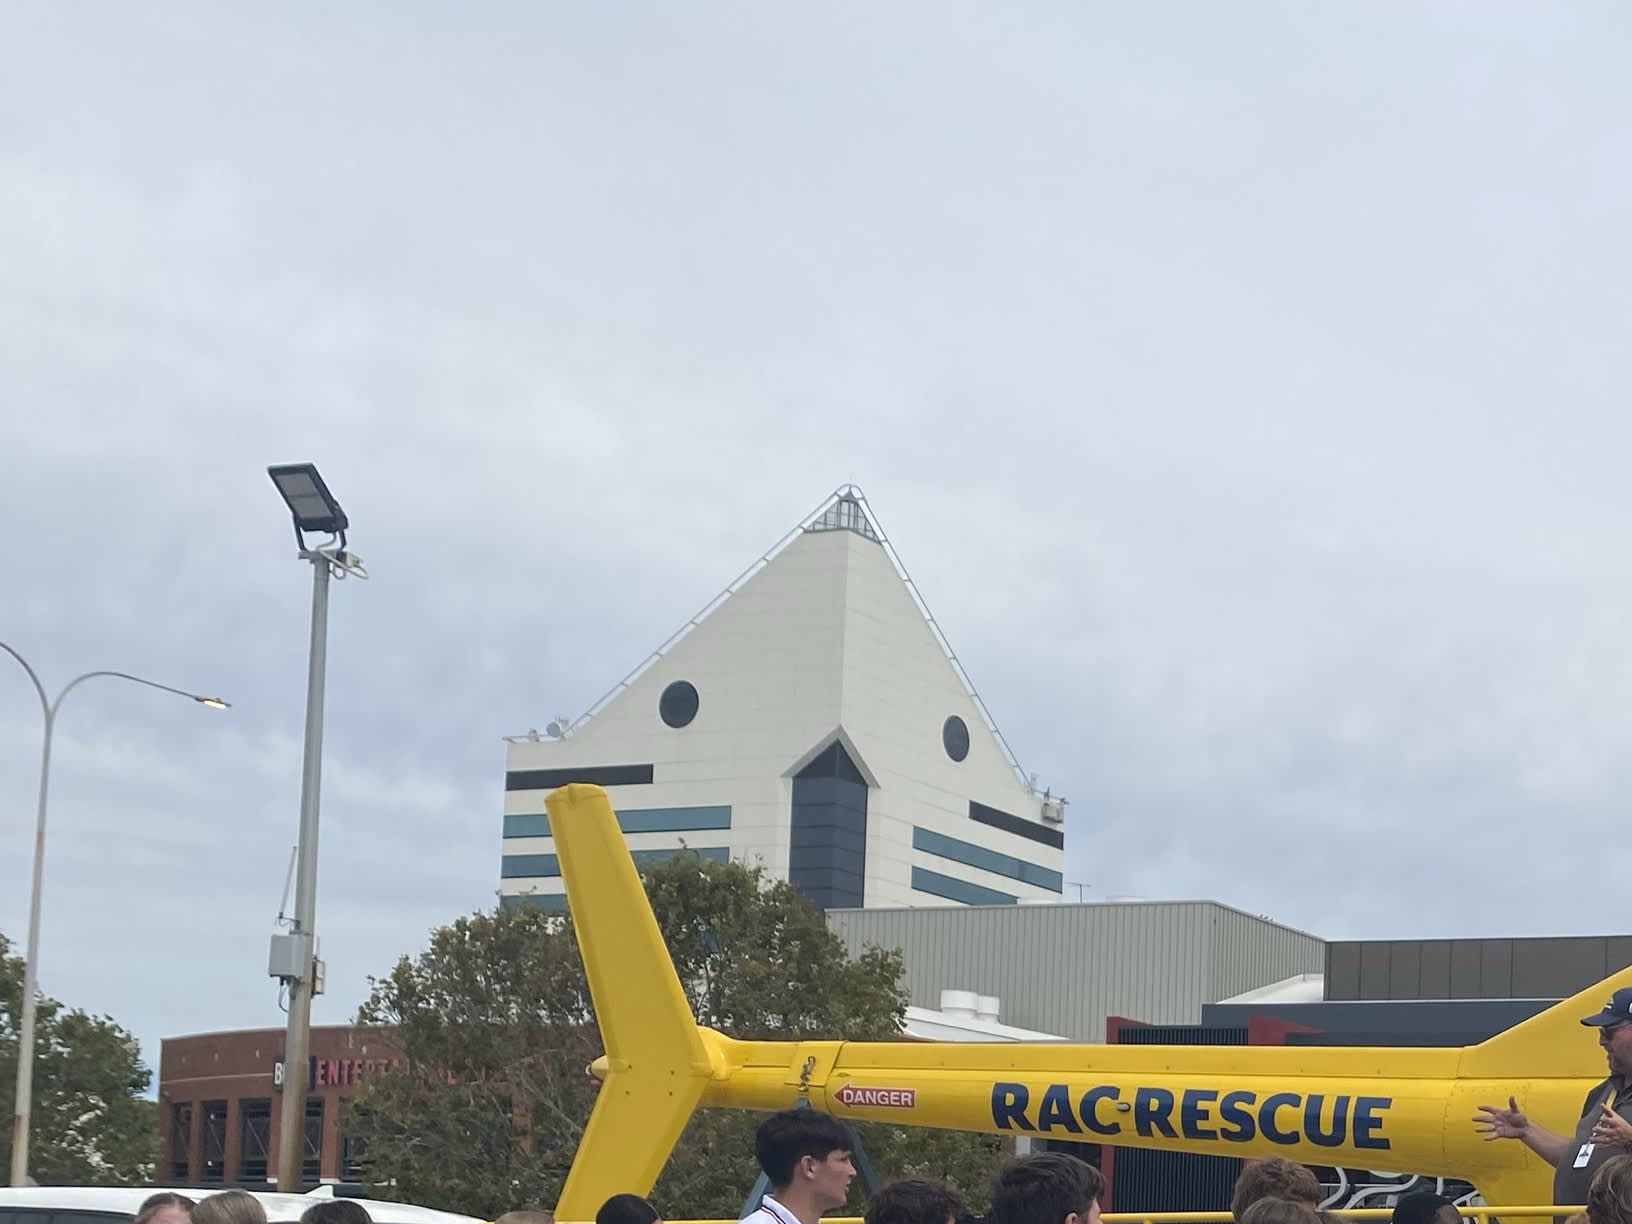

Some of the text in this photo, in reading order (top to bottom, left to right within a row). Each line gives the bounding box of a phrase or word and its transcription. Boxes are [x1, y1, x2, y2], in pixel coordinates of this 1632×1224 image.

[842, 1089, 914, 1108] DANGER
[991, 1082, 1392, 1150] RAC RESCUE
